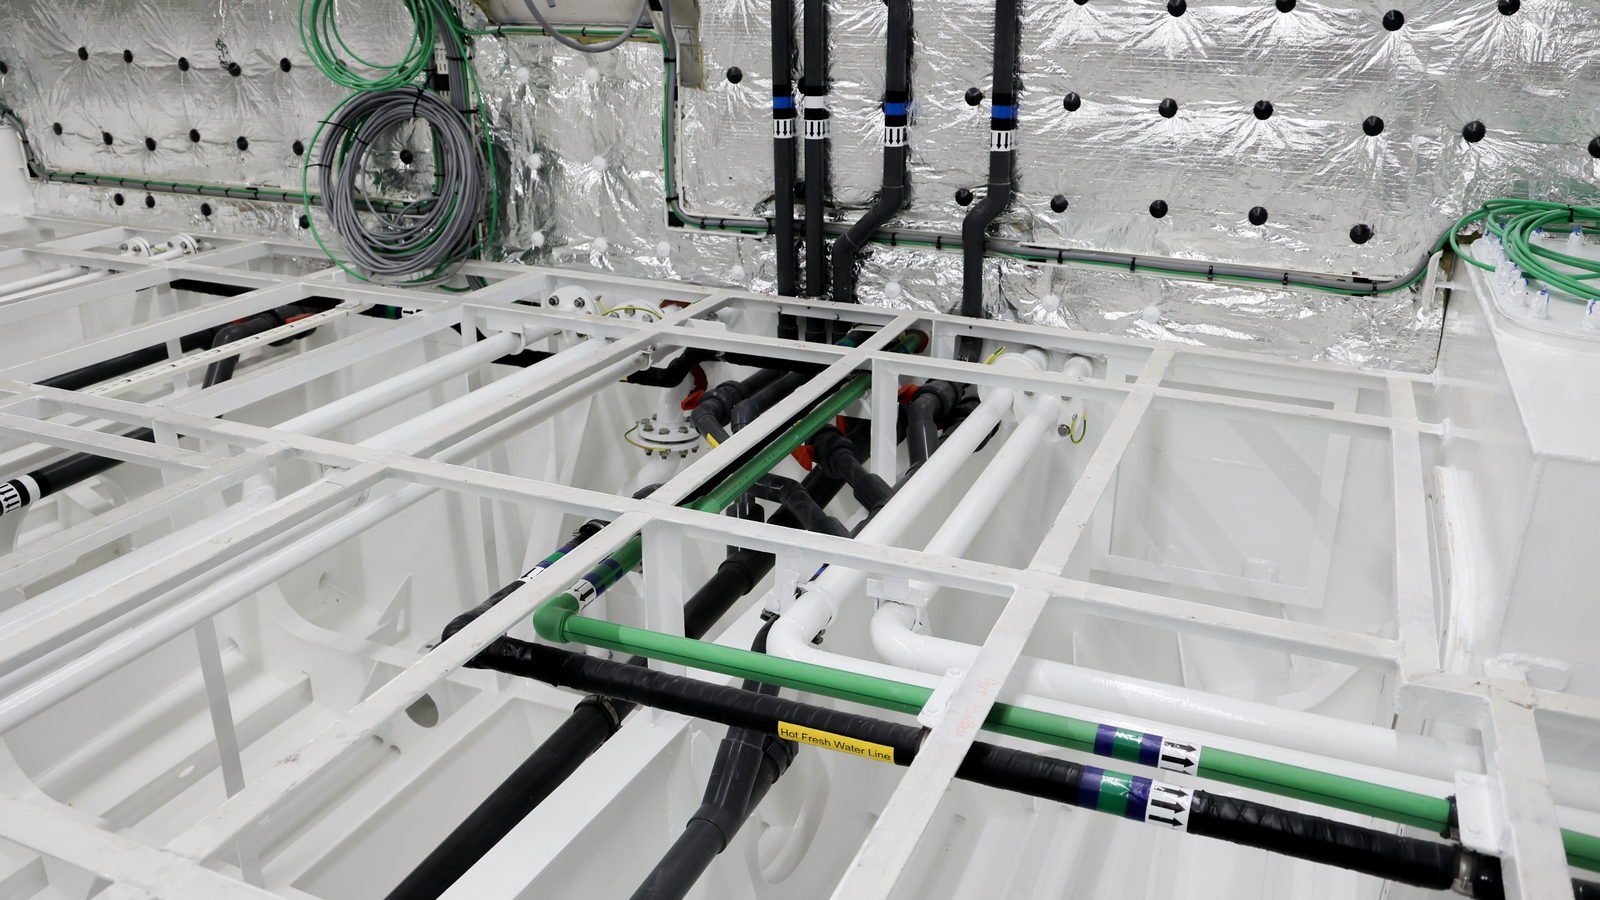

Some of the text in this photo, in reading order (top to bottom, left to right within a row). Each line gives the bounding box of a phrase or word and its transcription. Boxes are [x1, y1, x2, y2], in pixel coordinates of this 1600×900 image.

[780, 727, 891, 761] Hot Fresh Water Line
